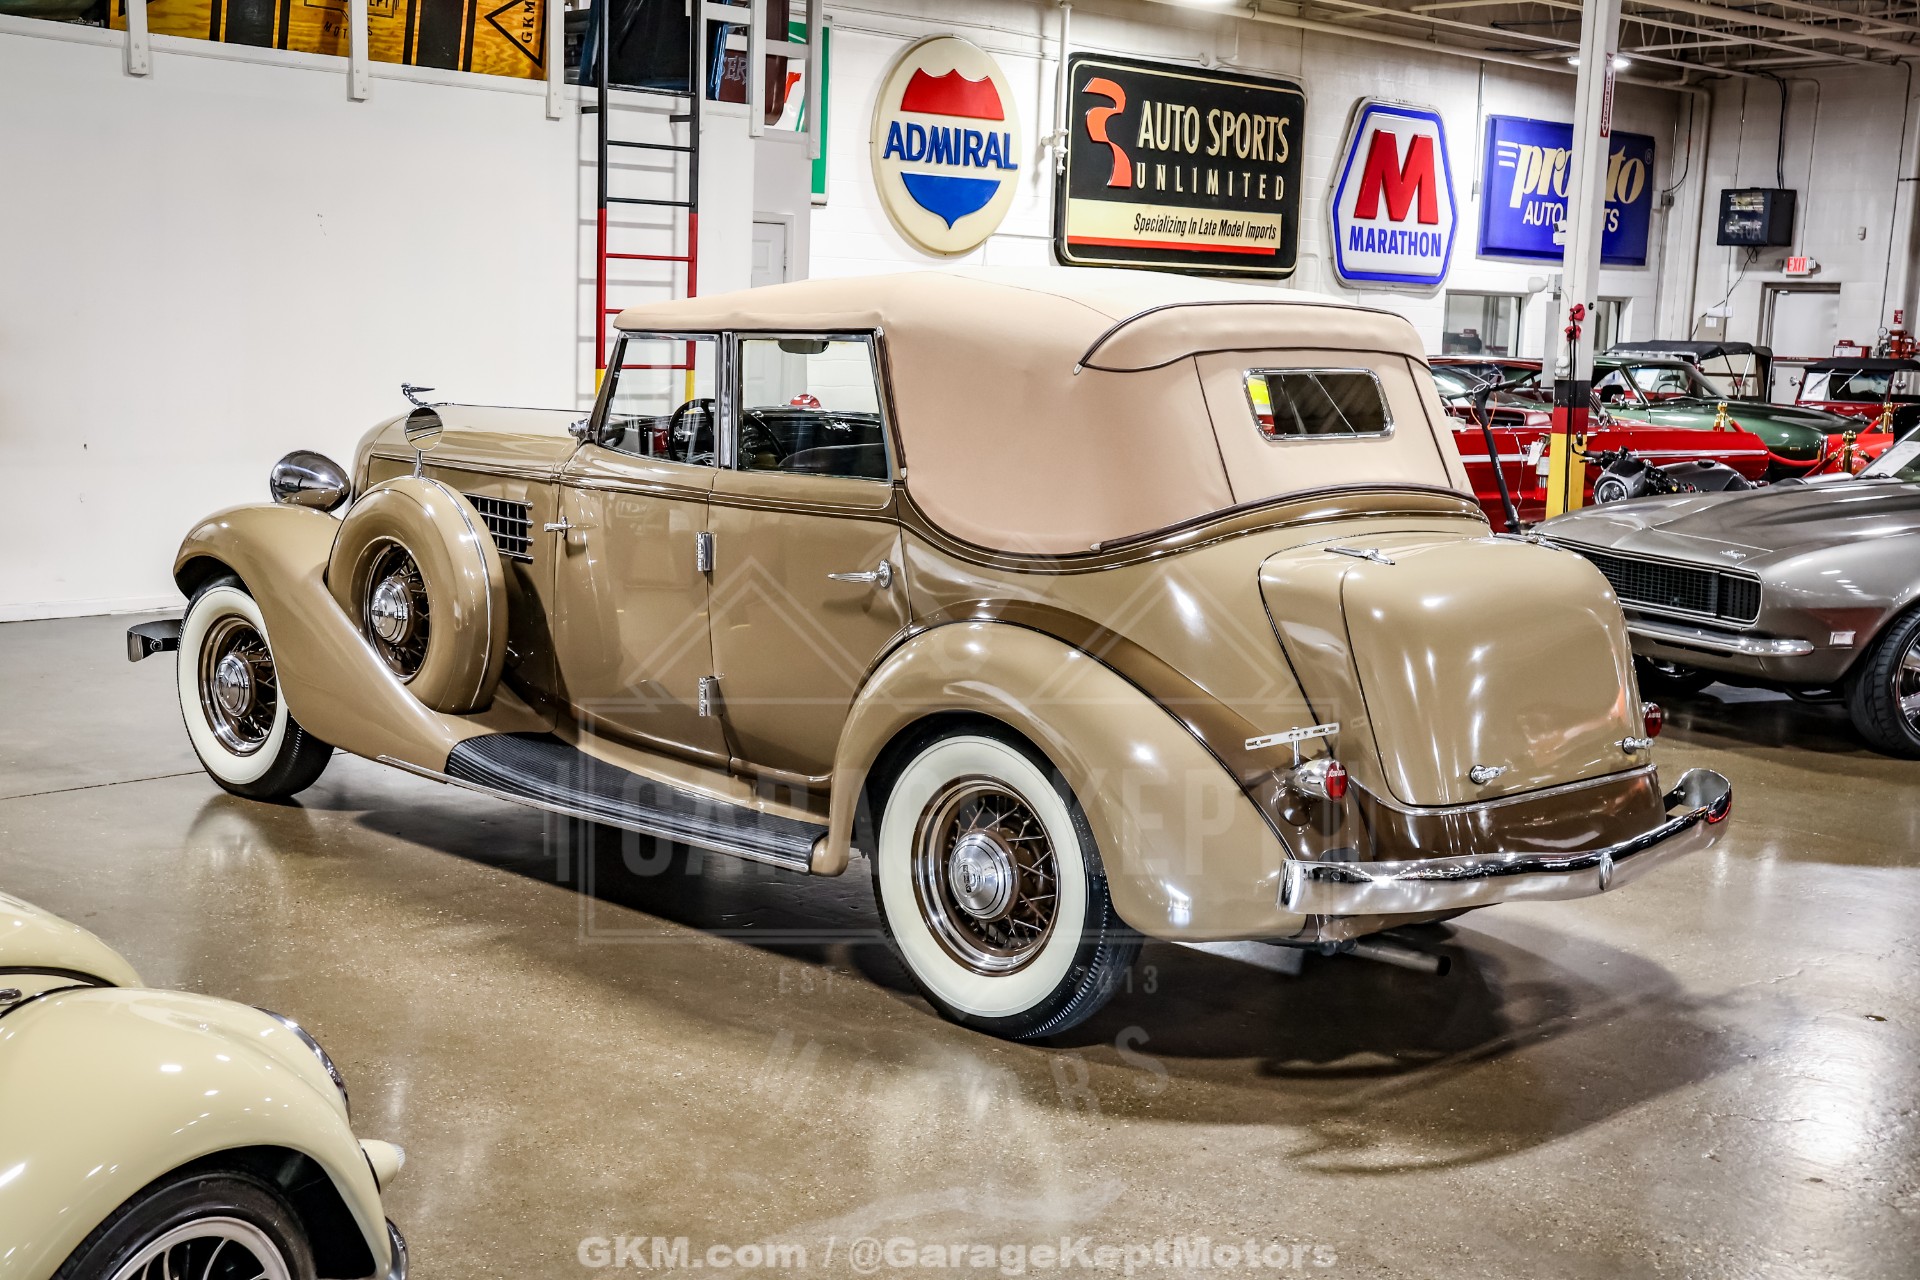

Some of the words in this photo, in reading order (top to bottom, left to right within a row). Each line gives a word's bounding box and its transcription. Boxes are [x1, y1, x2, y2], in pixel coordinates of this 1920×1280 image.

[324, 20, 373, 39] MOTS
[521, 0, 536, 43] GKM
[883, 121, 1018, 170] ADMIRAL
[1137, 100, 1200, 154] AUTO
[1206, 108, 1290, 164] SPORTS
[1136, 162, 1285, 201] UNLIMITED
[1354, 128, 1438, 225] M
[1510, 144, 1645, 208] proto
[1134, 213, 1186, 237] Specializing
[1189, 217, 1197, 233] In
[1198, 218, 1217, 236] Late
[1219, 219, 1244, 238] Model
[1245, 221, 1277, 241] Imports
[1523, 201, 1564, 226] AUTO
[1349, 225, 1442, 258] MARATHON
[1787, 257, 1807, 273] EXIT
